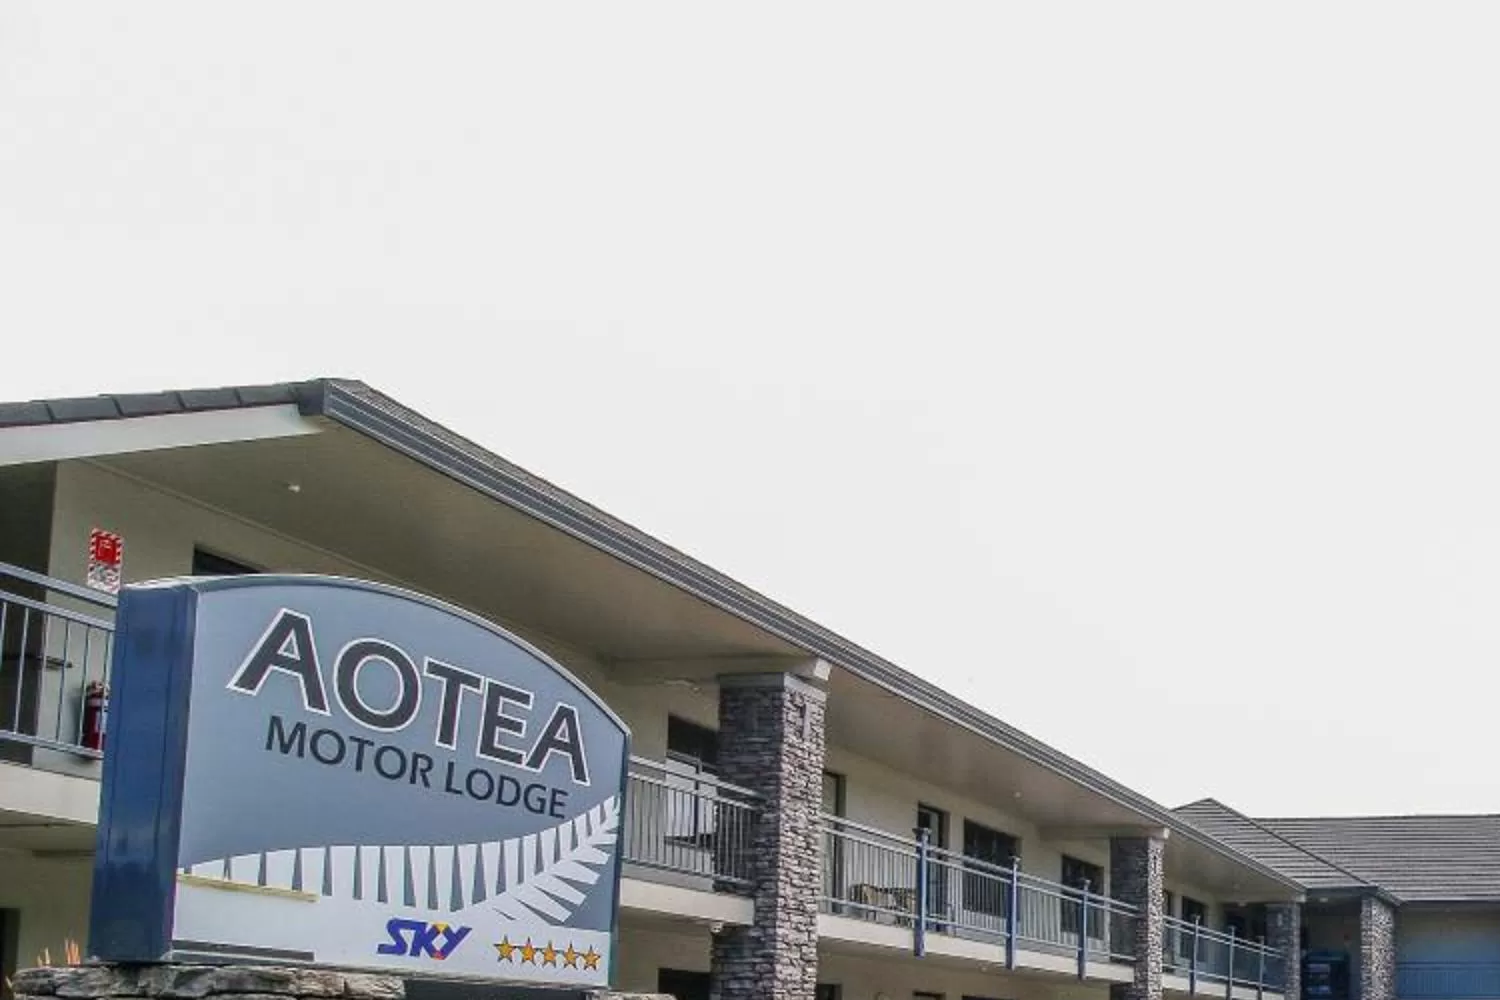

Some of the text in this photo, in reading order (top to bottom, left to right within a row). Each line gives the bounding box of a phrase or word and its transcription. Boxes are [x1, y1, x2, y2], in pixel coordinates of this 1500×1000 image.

[226, 608, 591, 786] AOTEA
[265, 715, 569, 819] MOTOR LODGE
[377, 918, 473, 960] SKY
